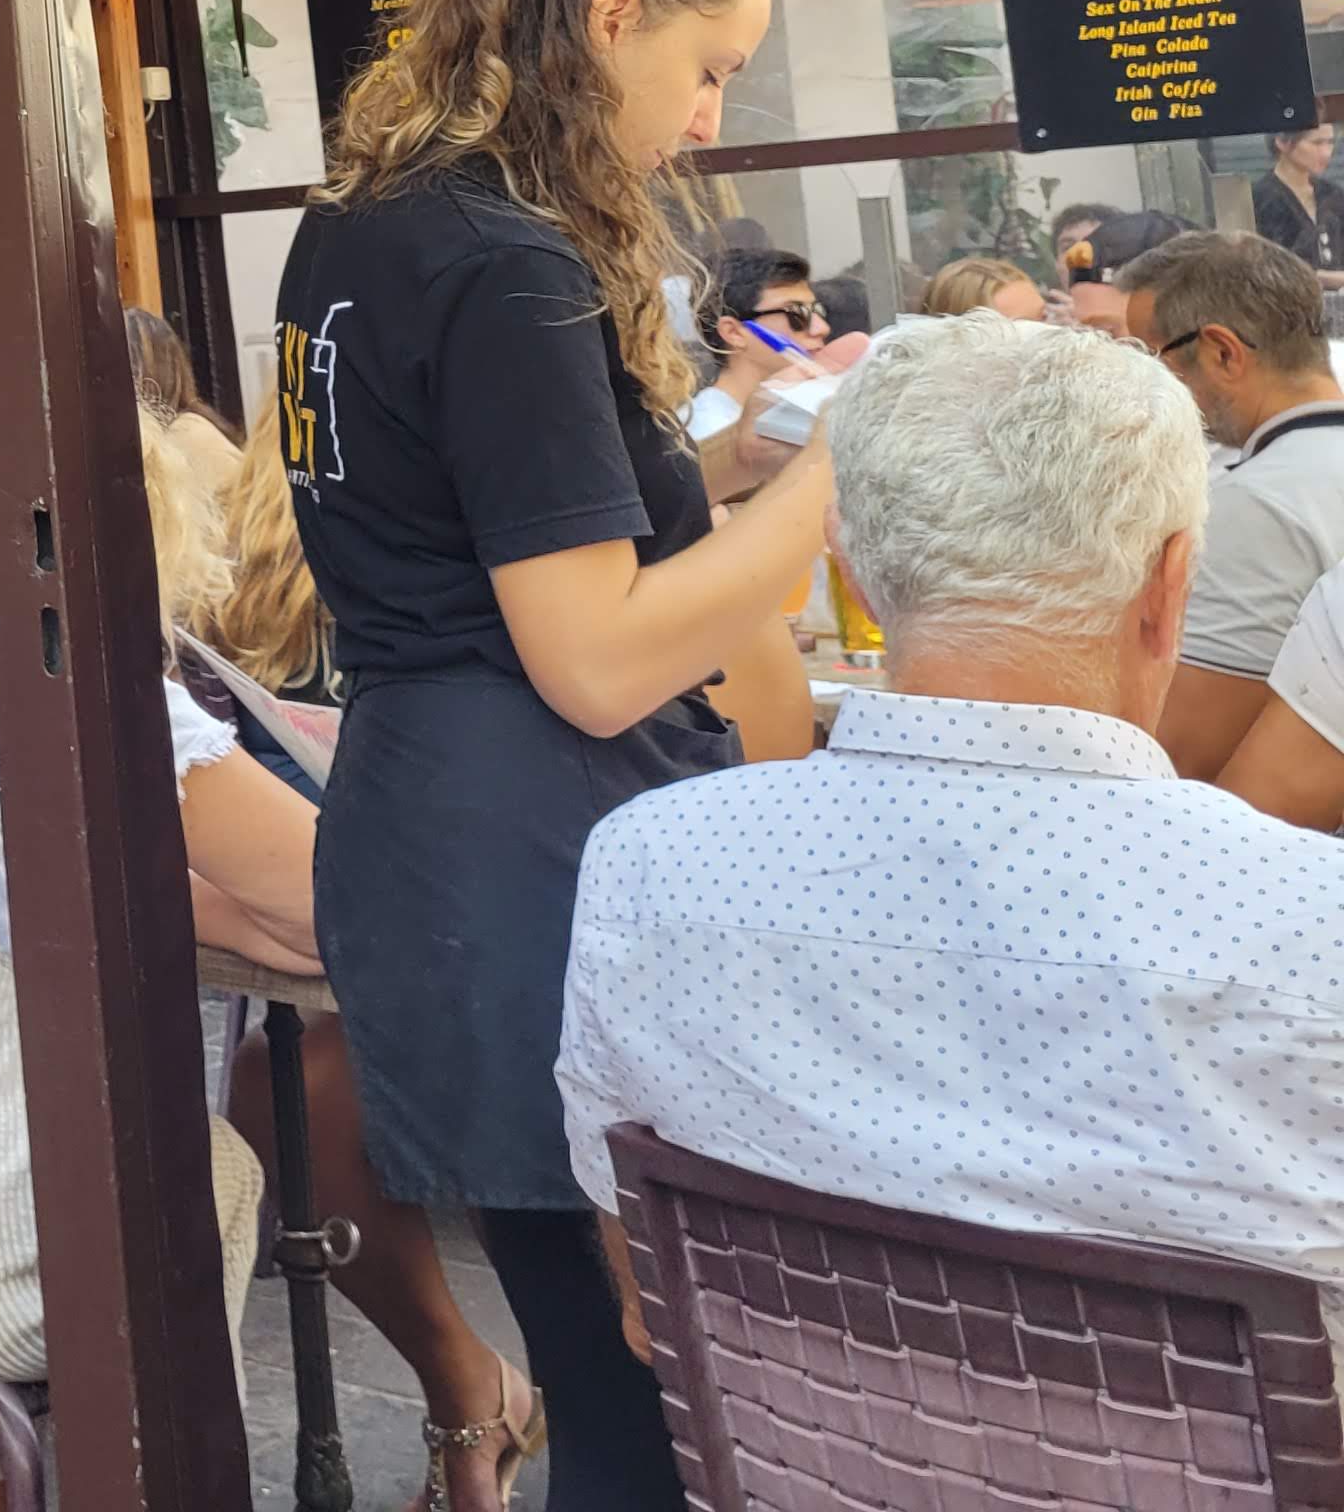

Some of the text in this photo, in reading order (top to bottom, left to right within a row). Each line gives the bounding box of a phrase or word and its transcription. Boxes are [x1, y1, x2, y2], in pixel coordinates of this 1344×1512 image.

[1086, 1, 1115, 17] Sex
[1078, 11, 1237, 41] Long Island Iced Tea
[1156, 35, 1209, 54] Colada
[1126, 60, 1198, 79] Caipirina
[1115, 85, 1153, 102] Irish
[1131, 106, 1158, 122] Gin
